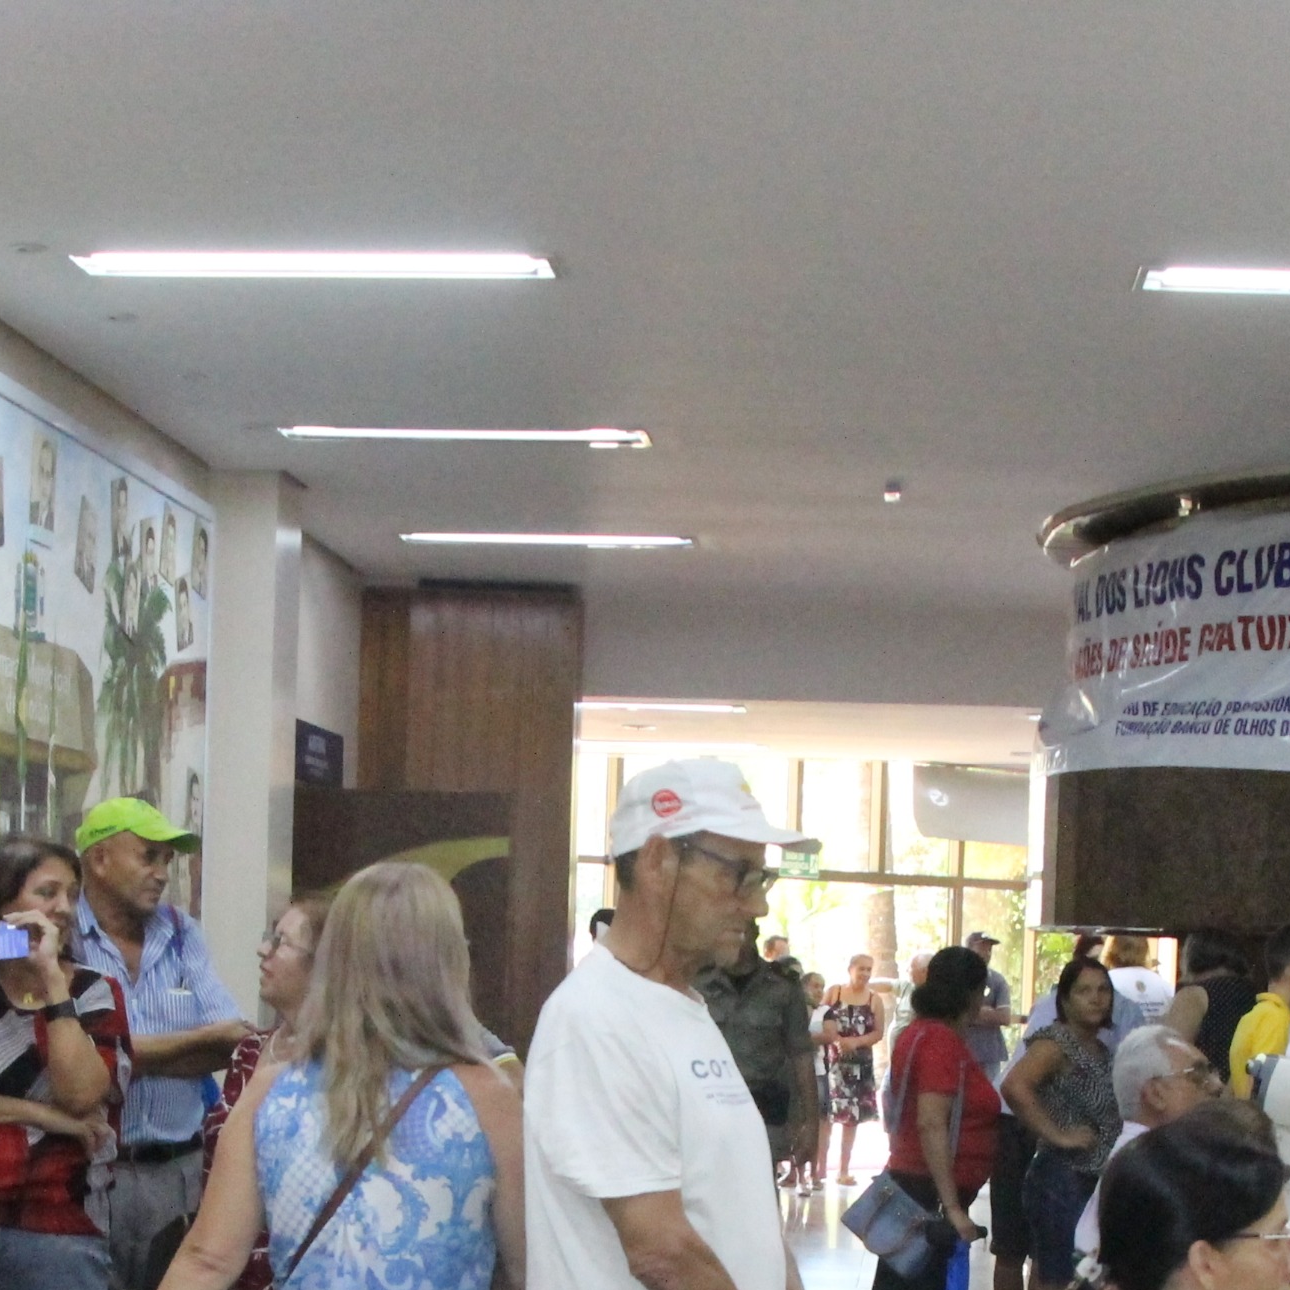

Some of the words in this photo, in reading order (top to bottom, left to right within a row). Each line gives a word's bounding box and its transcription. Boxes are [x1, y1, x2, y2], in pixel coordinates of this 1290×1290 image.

[1096, 571, 1127, 617] DOS
[1132, 553, 1205, 609] LIONS
[1130, 621, 1191, 669] SAÚDE
[1143, 701, 1159, 717] DE
[1213, 720, 1230, 736] DE
[1234, 717, 1275, 738] OLHOS
